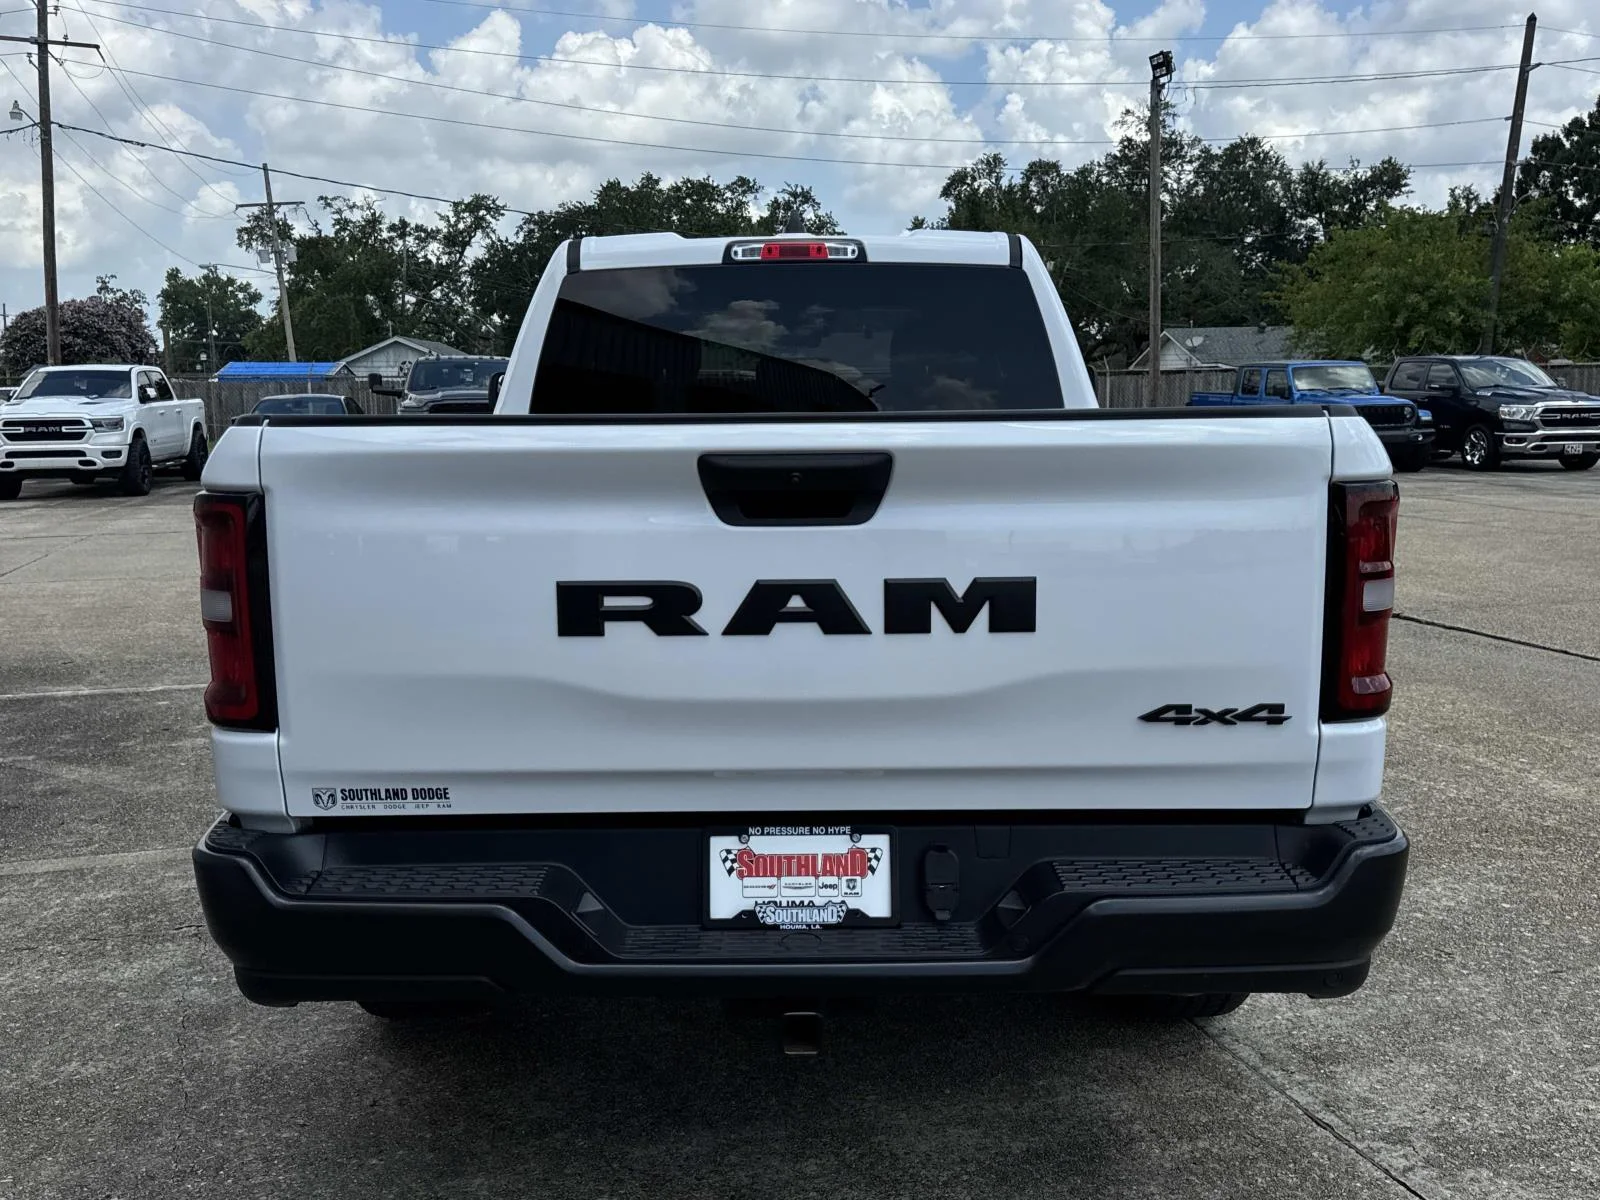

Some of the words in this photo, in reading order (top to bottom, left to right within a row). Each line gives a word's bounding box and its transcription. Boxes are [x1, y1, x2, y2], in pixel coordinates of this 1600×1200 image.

[556, 576, 1038, 638] RAM
[1137, 702, 1293, 726] 4x4
[340, 787, 408, 801] SOUTHLAND
[411, 787, 450, 801] DODGE
[749, 827, 761, 835] NO
[764, 827, 811, 835] PRESSURE
[812, 827, 826, 835] NO
[828, 826, 851, 835] HYPE
[736, 848, 869, 880] SOUTHLAND
[818, 882, 838, 891] Jeep
[765, 905, 839, 923] SOUTHLAND
